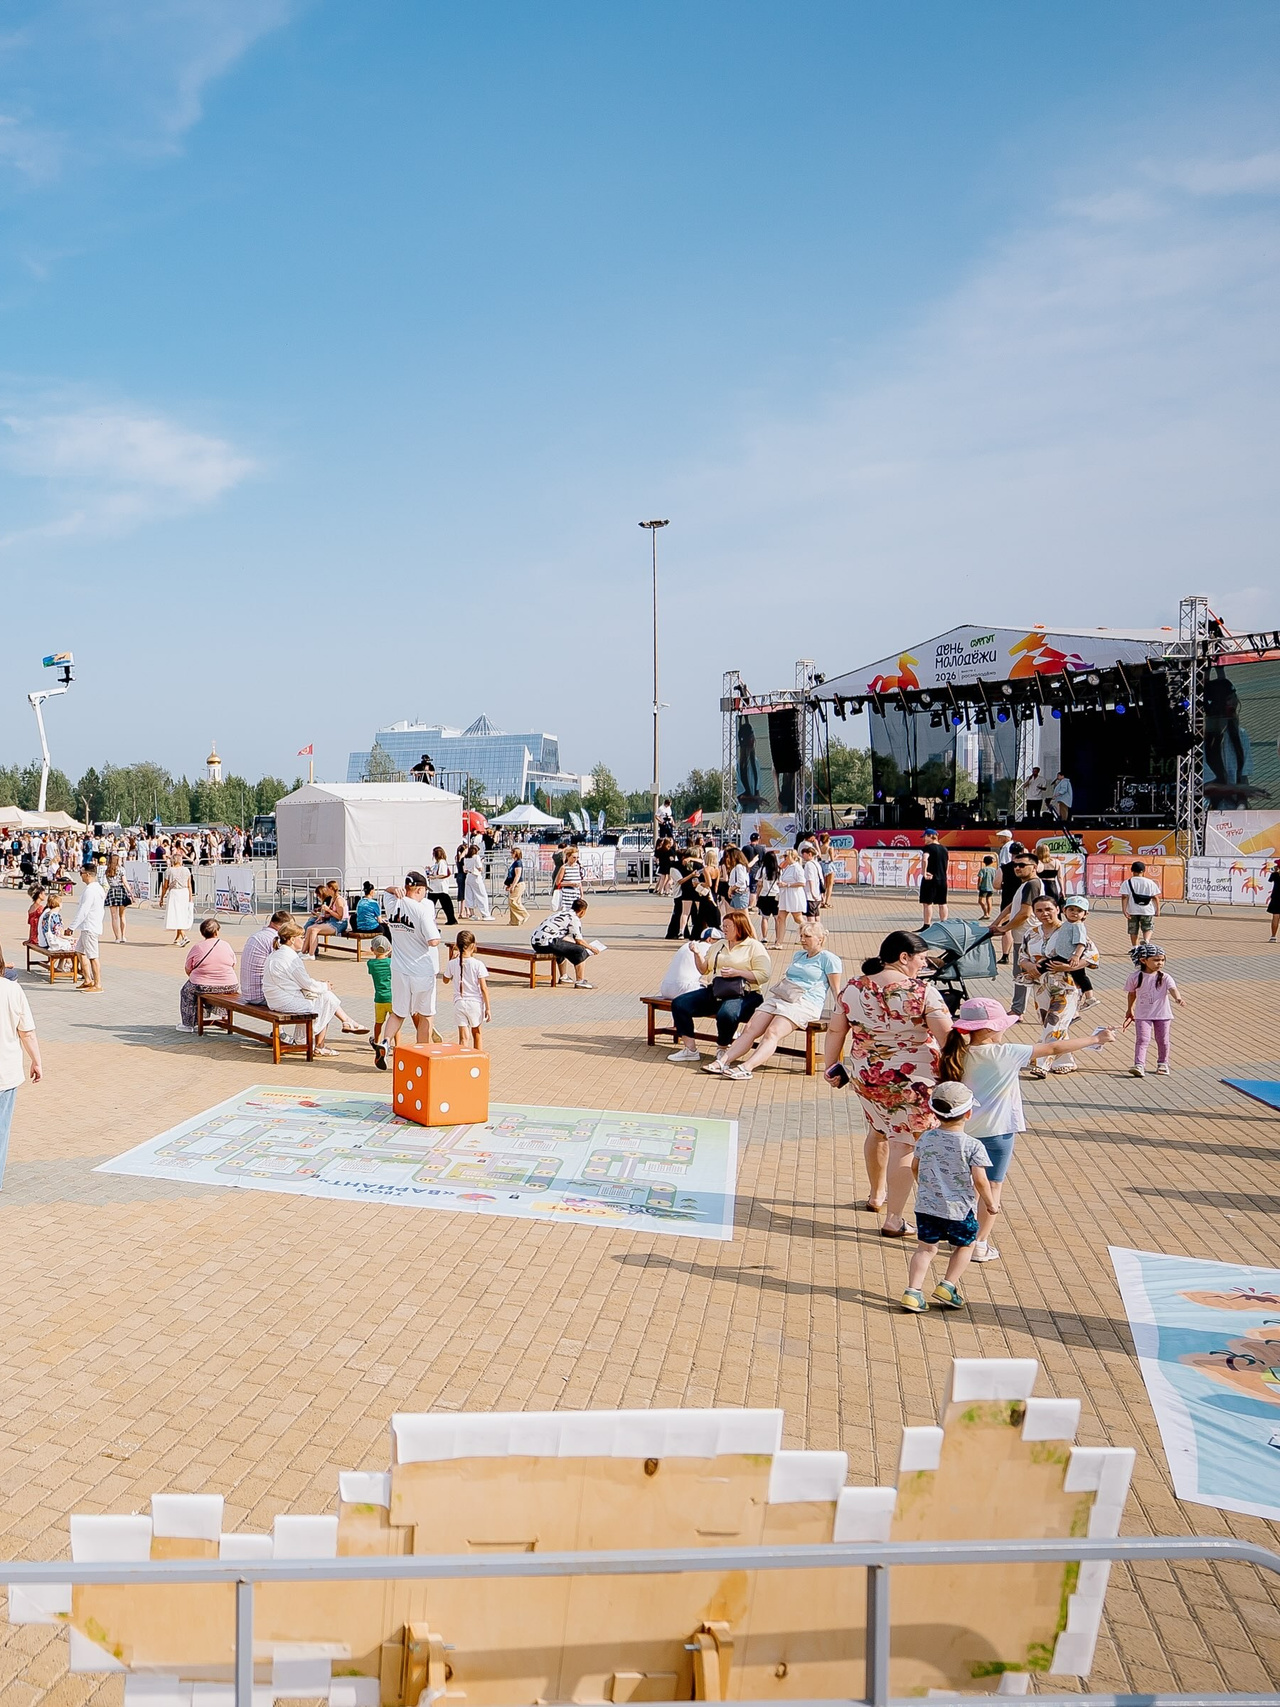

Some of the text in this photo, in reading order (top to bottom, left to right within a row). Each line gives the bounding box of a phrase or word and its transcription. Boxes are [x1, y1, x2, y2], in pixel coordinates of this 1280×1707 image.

[970, 633, 996, 648] СУРГУТ
[935, 641, 964, 657] ДЕНЬ
[934, 649, 997, 669] МОЛОДЁЖИ
[934, 671, 957, 682] 2026
[1192, 877, 1211, 885] ДЕНЬ
[1191, 884, 1232, 892] МОЛОДЁЖИ
[319, 1179, 456, 1196] «ВАРИАНТ»
[356, 1188, 403, 1197] ТВОЙ
[547, 1205, 608, 1215] СТАРТ
